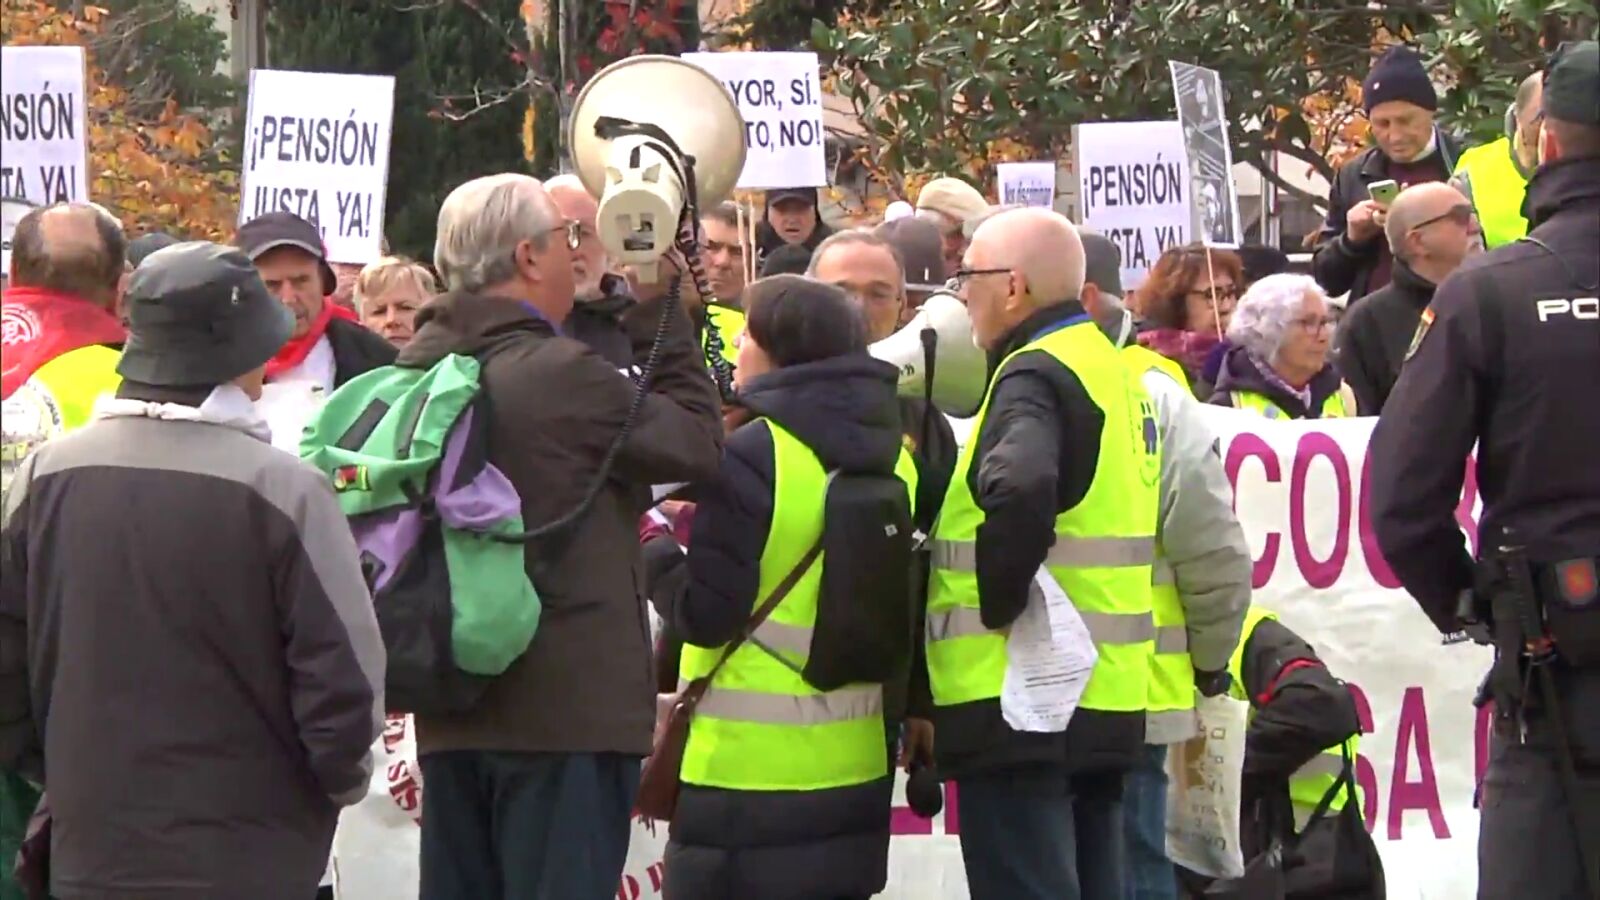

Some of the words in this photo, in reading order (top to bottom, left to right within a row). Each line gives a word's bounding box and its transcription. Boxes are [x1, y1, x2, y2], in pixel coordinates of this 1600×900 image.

[721, 79, 782, 111] YOR,
[790, 72, 818, 105] SÍ.
[251, 108, 379, 171] ¡PENSIÓN
[779, 119, 821, 146] NO!
[1083, 152, 1182, 219] ¡PENSIÓN
[336, 190, 372, 238] YA!
